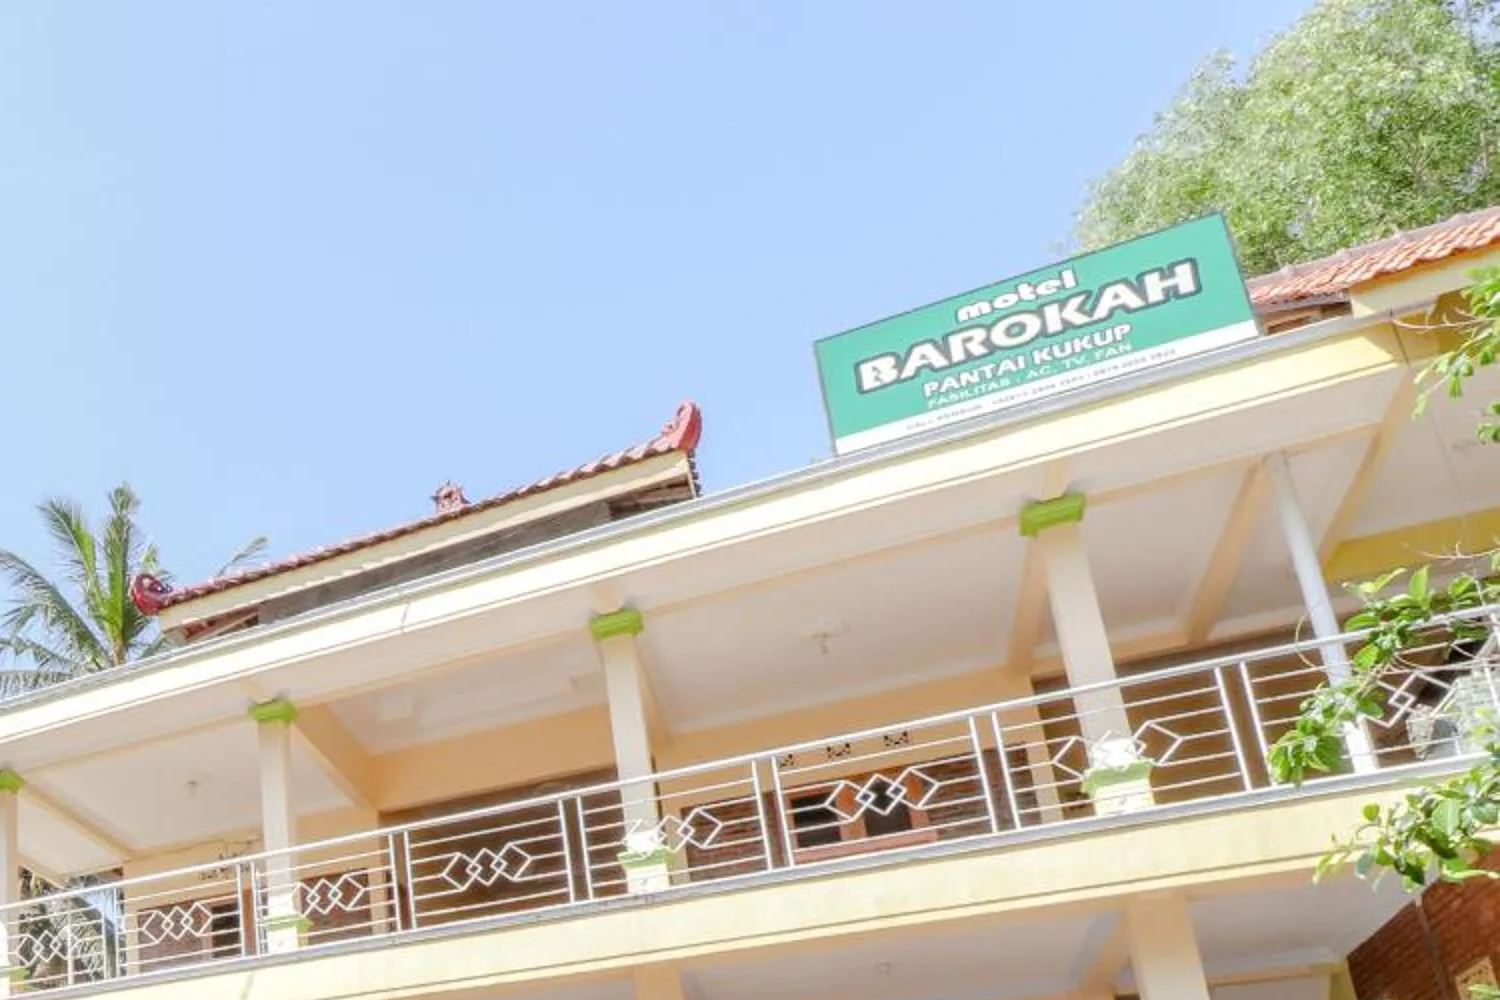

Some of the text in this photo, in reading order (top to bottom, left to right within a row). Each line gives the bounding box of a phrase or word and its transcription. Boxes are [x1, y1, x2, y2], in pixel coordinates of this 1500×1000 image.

[859, 259, 1198, 392] BAROKAH
[956, 268, 1078, 323] motel
[924, 355, 1026, 398] PANTAI
[1033, 324, 1132, 364] KUKUP
